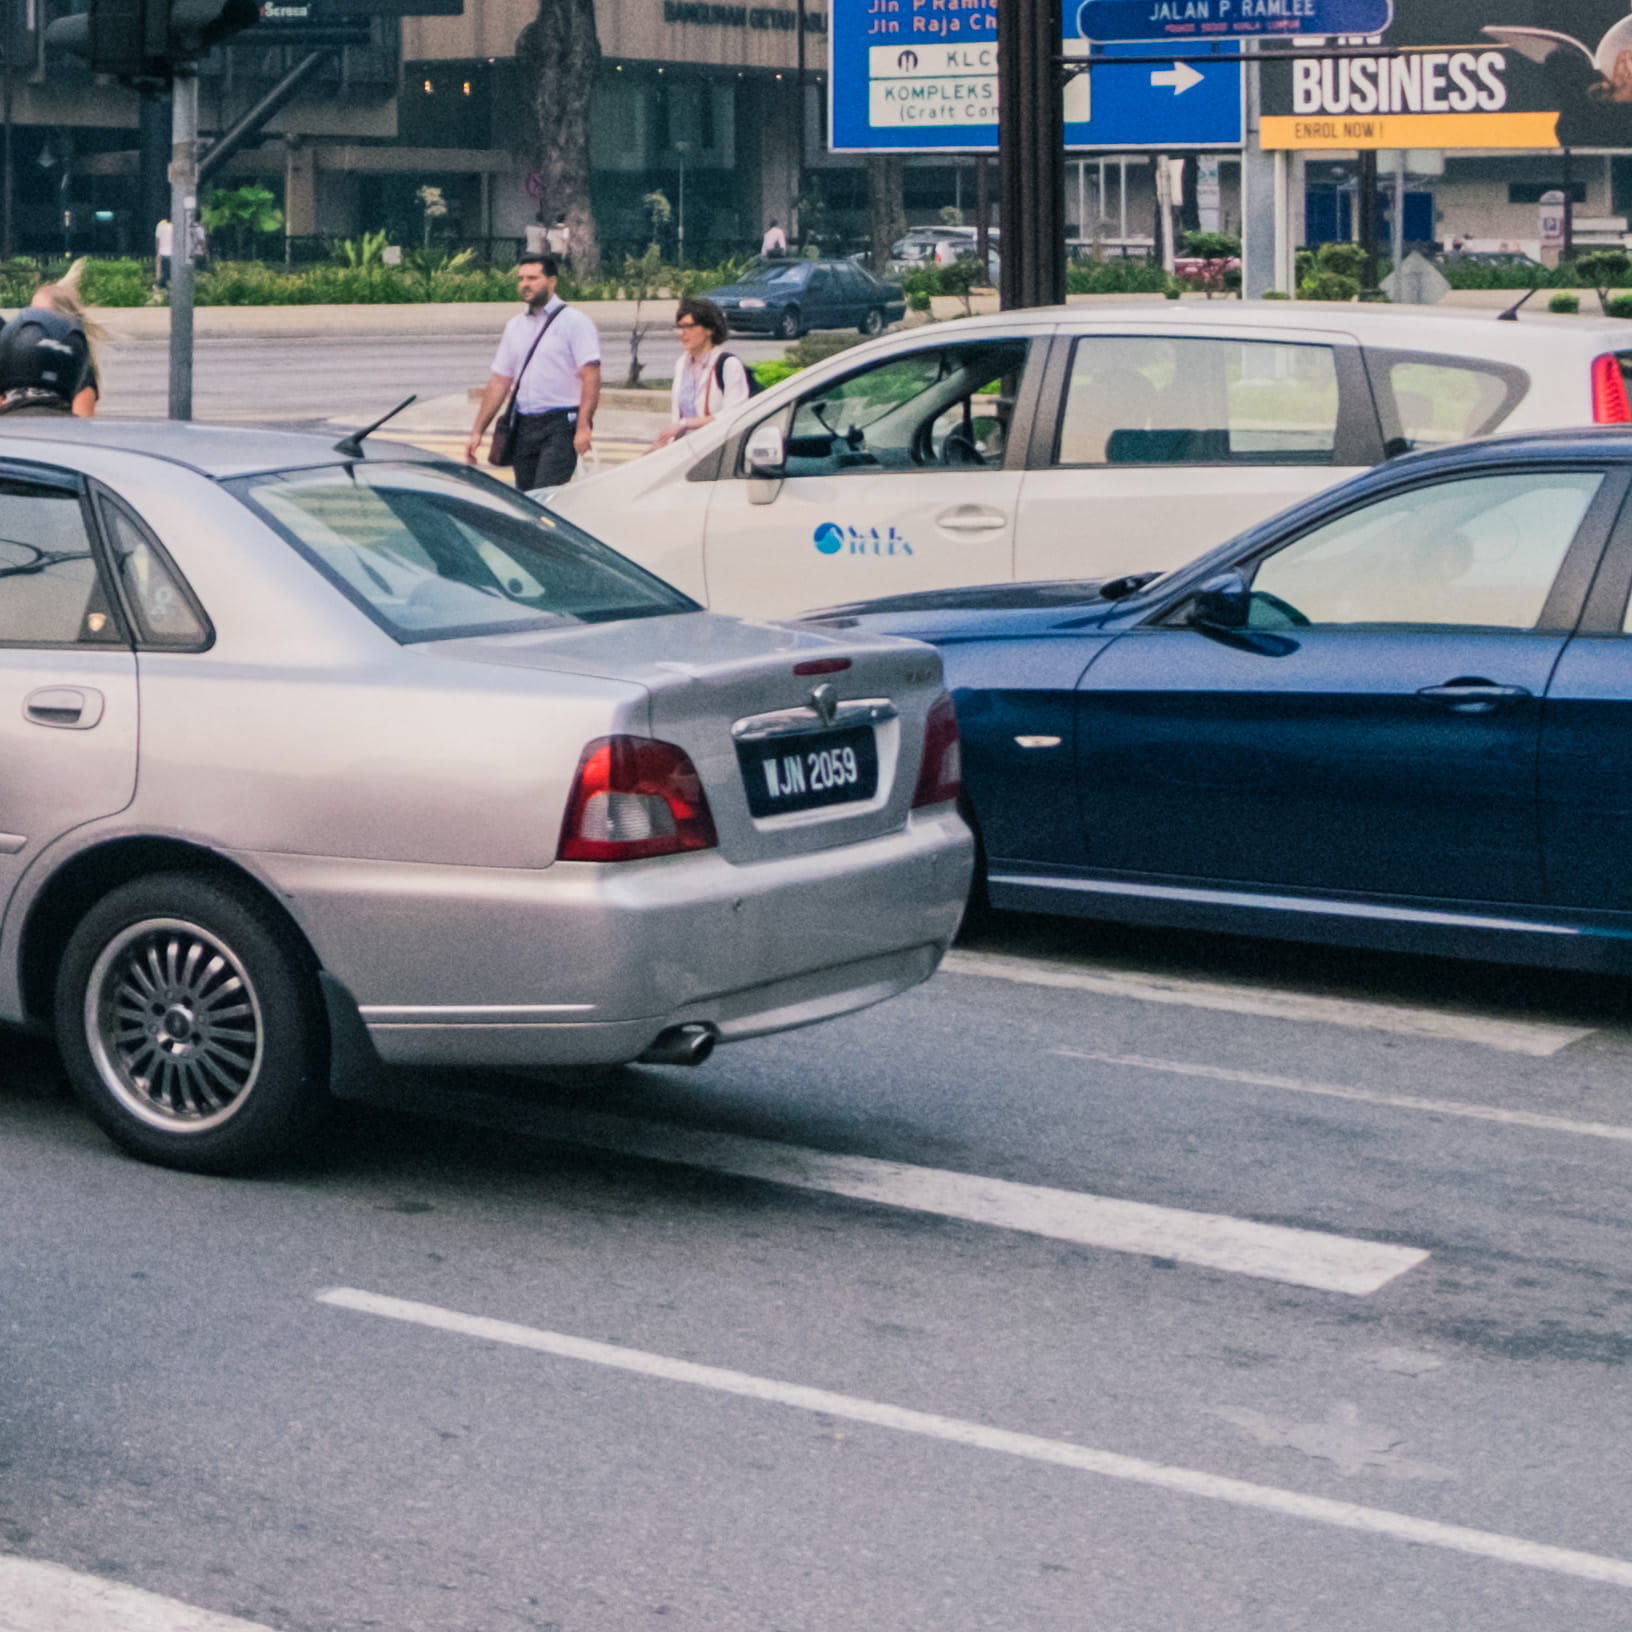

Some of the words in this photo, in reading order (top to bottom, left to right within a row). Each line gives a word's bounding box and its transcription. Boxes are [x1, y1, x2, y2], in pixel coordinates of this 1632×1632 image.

[1149, 0, 1209, 22] JALAN
[868, 19, 900, 35] Jln
[913, 16, 961, 37] Raja
[947, 50, 998, 68] KLC
[1292, 51, 1507, 114] BUSINESS
[884, 84, 993, 102] KOMPLEKS
[899, 106, 955, 122] (Craft
[1294, 122, 1338, 140] ENROL
[1343, 122, 1375, 138] NOW
[762, 751, 806, 798] WJN
[807, 745, 858, 792] 2059
